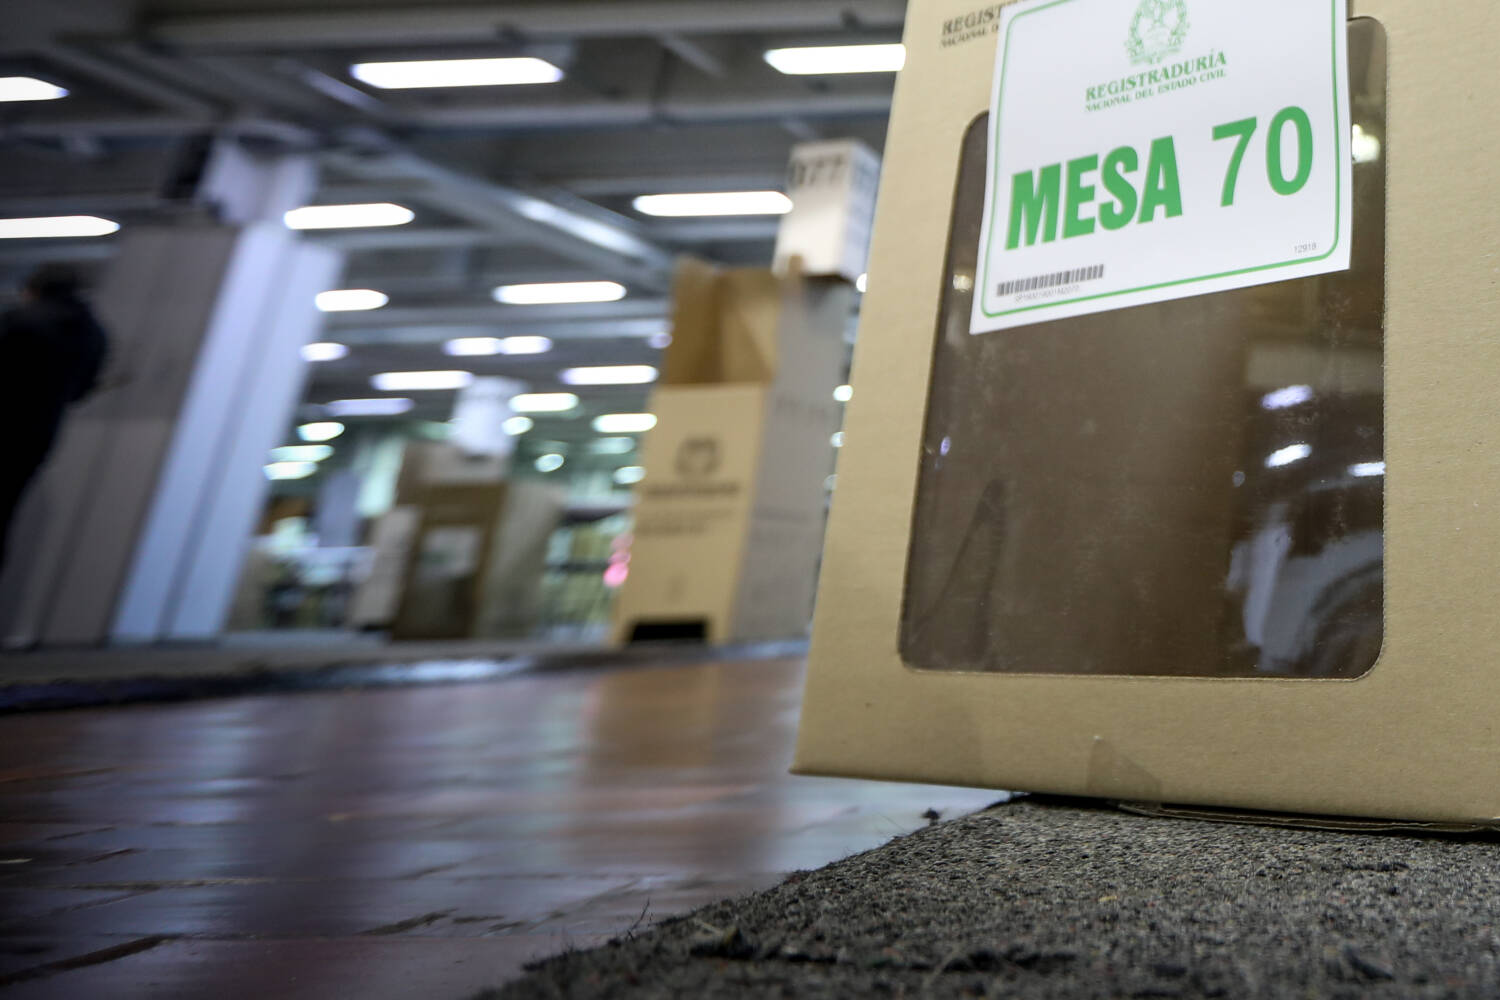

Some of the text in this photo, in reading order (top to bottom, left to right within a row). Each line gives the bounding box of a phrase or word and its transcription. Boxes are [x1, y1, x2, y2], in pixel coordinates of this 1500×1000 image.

[1085, 48, 1227, 102] REGISTRADURÍA
[1085, 69, 1226, 112] NACIONAL DEL ESTADO CIVIL
[1005, 106, 1314, 251] MESA 70
